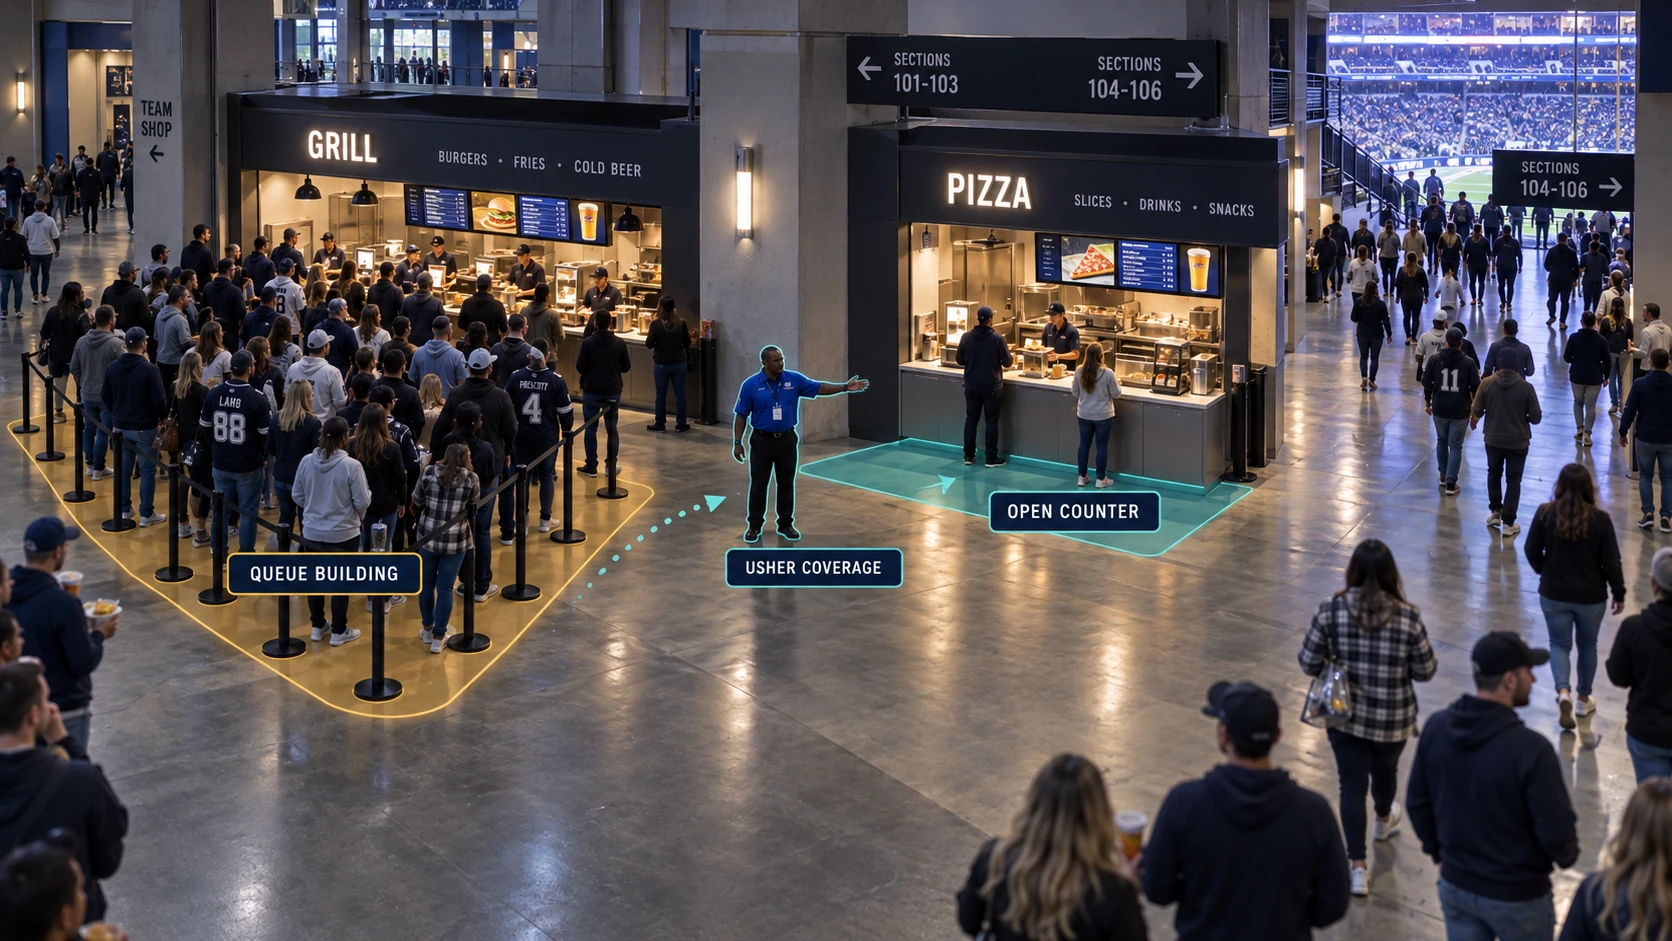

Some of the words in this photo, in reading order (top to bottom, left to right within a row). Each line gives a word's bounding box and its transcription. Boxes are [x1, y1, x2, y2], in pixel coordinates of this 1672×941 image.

[893, 52, 951, 67] SECTIONS
[1097, 55, 1162, 72] SECTIONS
[893, 73, 959, 94] 101-103
[1088, 78, 1162, 101] 104-106
[140, 100, 173, 117] TEAM
[141, 120, 173, 138] SHOP
[307, 130, 378, 164] GRILL
[438, 150, 488, 166] BURGERS
[513, 155, 546, 170] FRIES
[574, 159, 605, 175] COLD
[611, 163, 642, 178] BEER
[1521, 160, 1580, 175] SECTIONS
[947, 172, 1032, 210] PIZZA
[1520, 178, 1588, 200] 104-106
[1074, 193, 1112, 208] SLICES
[1139, 198, 1182, 213] DRINKS
[1209, 202, 1255, 218] SNACKS
[1440, 368, 1460, 393] 11
[521, 392, 543, 425] 4
[213, 410, 246, 445] 88
